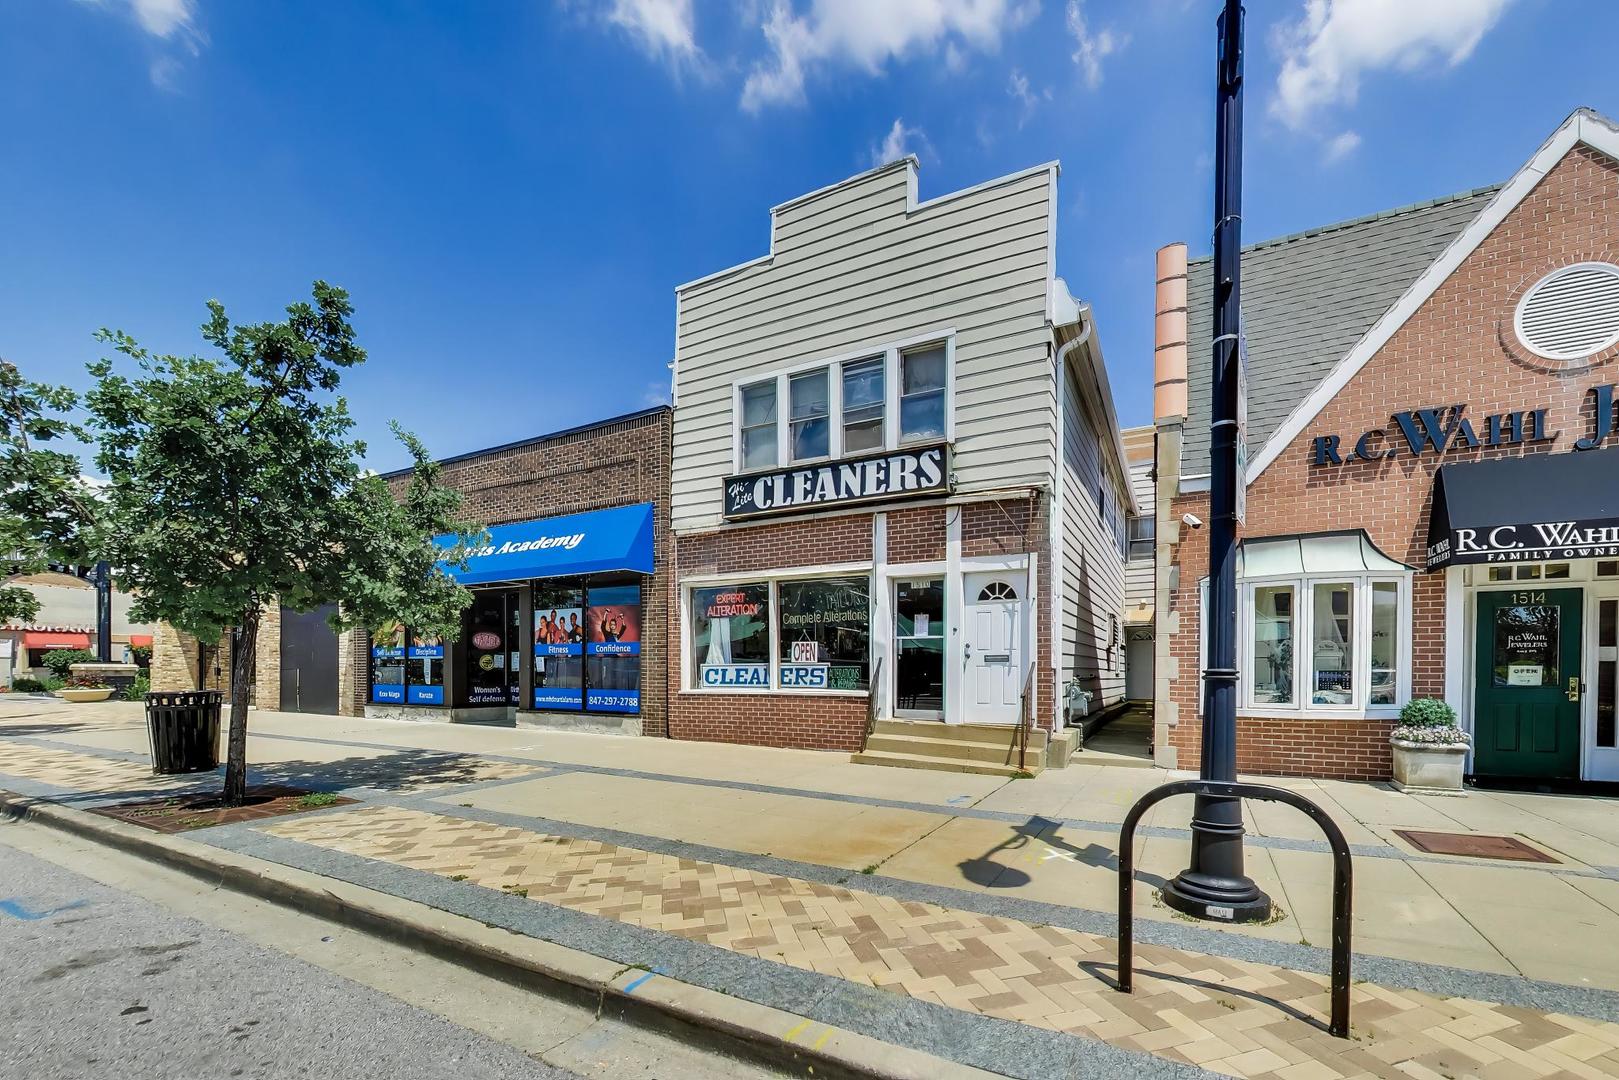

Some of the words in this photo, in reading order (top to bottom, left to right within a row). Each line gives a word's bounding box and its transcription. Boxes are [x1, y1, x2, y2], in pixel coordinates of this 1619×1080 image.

[753, 449, 942, 509] CLEANERS
[495, 532, 586, 555] Academy
[1455, 526, 1524, 551] R.C.
[1487, 550, 1553, 562] FAMILY
[716, 592, 745, 604] EXPERT
[1511, 592, 1546, 604] 1514
[782, 610, 822, 626] Complete
[823, 609, 868, 623] Alterations
[548, 646, 569, 654] Fitness
[595, 644, 631, 653] Confidence
[793, 642, 816, 662] OPEN
[474, 686, 501, 694] Women's
[469, 695, 482, 703] Self
[482, 695, 506, 703] defense
[588, 696, 638, 707] 847-297-2788
